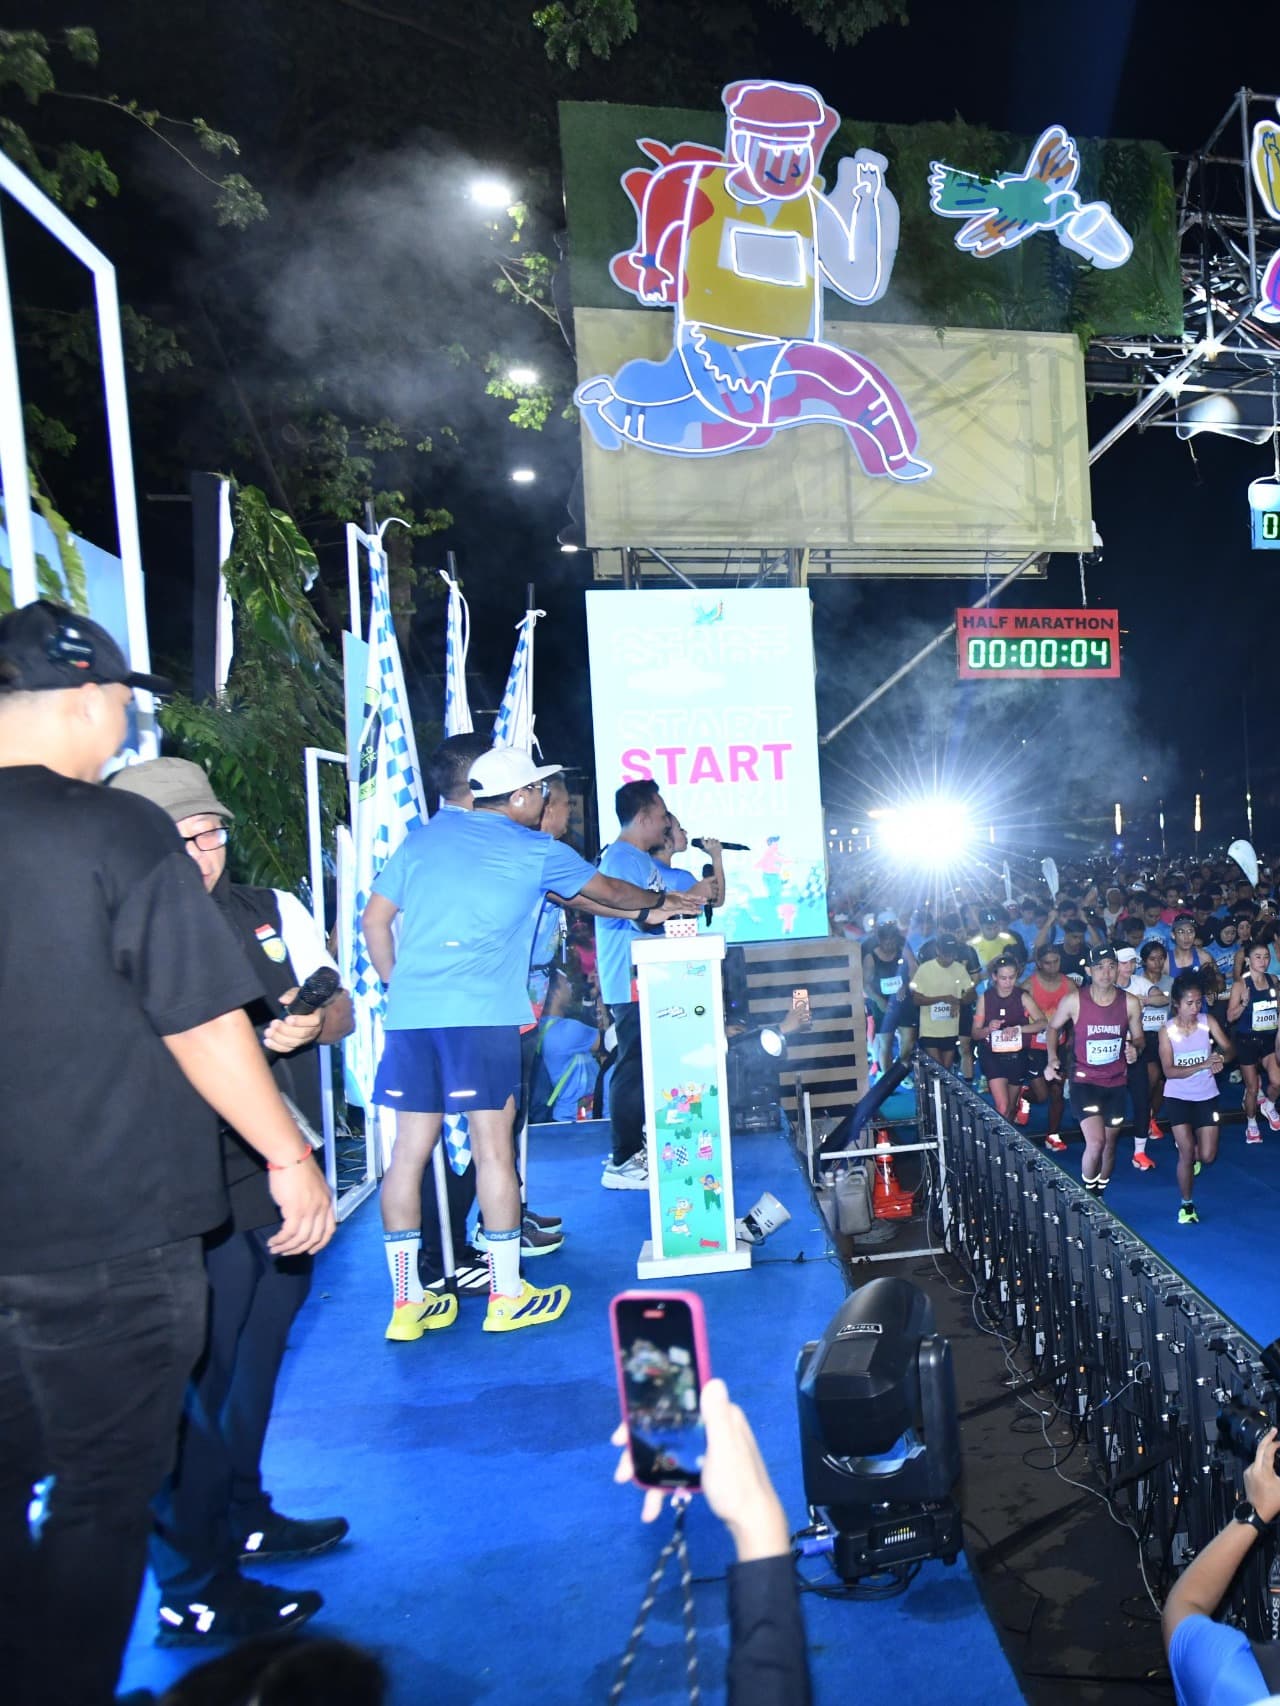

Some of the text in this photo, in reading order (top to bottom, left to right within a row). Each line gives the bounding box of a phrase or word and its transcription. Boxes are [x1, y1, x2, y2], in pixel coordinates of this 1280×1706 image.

[962, 616, 1114, 630] HALF MARATHON
[968, 639, 1108, 668] 00:00:04
[621, 743, 792, 785] START
[1091, 1044, 1117, 1054] 25412
[1271, 1597, 1280, 1640] SONY
